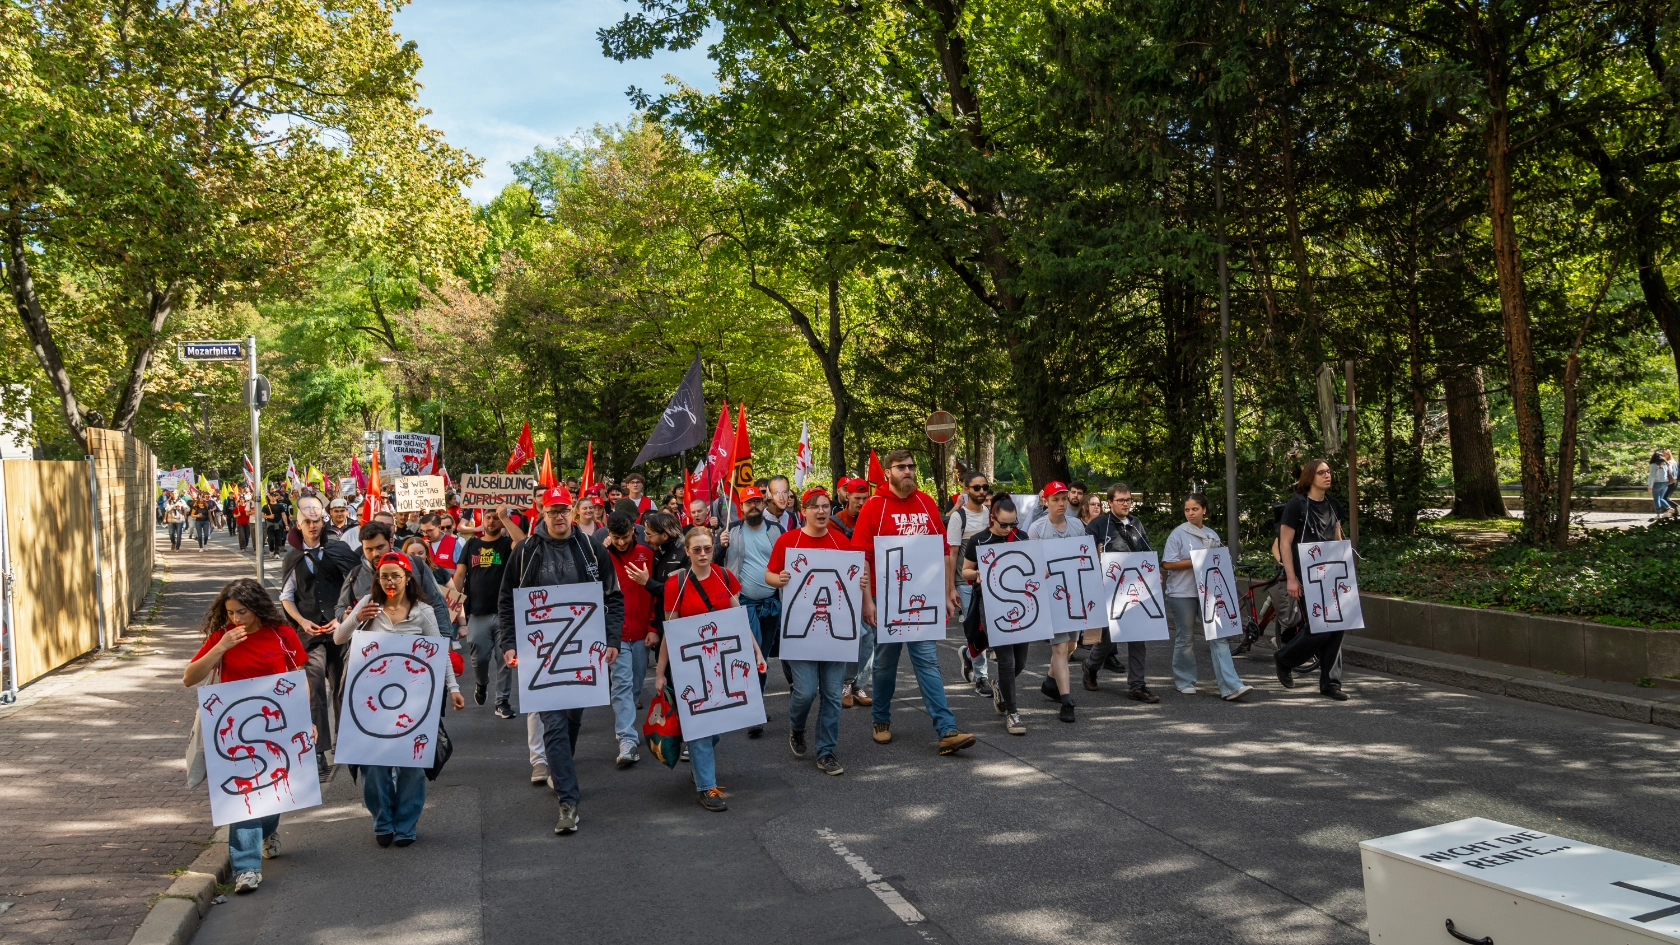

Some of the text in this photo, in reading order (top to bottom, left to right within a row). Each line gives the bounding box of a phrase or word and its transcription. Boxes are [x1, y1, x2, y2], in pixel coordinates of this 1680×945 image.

[187, 346, 237, 356] Mozartplatz
[462, 491, 533, 506] AUFRÜSTUNG
[891, 513, 929, 525] TARIF
[783, 568, 857, 640] A
[884, 547, 938, 629] L
[986, 550, 1040, 632] S
[1046, 555, 1095, 619] T
[1110, 567, 1165, 621] A
[1204, 566, 1237, 623] A
[1307, 560, 1349, 623] T
[525, 602, 598, 690] Z
[680, 635, 748, 716] I
[349, 653, 435, 739] O
[214, 695, 290, 796] S
[1420, 831, 1547, 863] NICHT DIE
